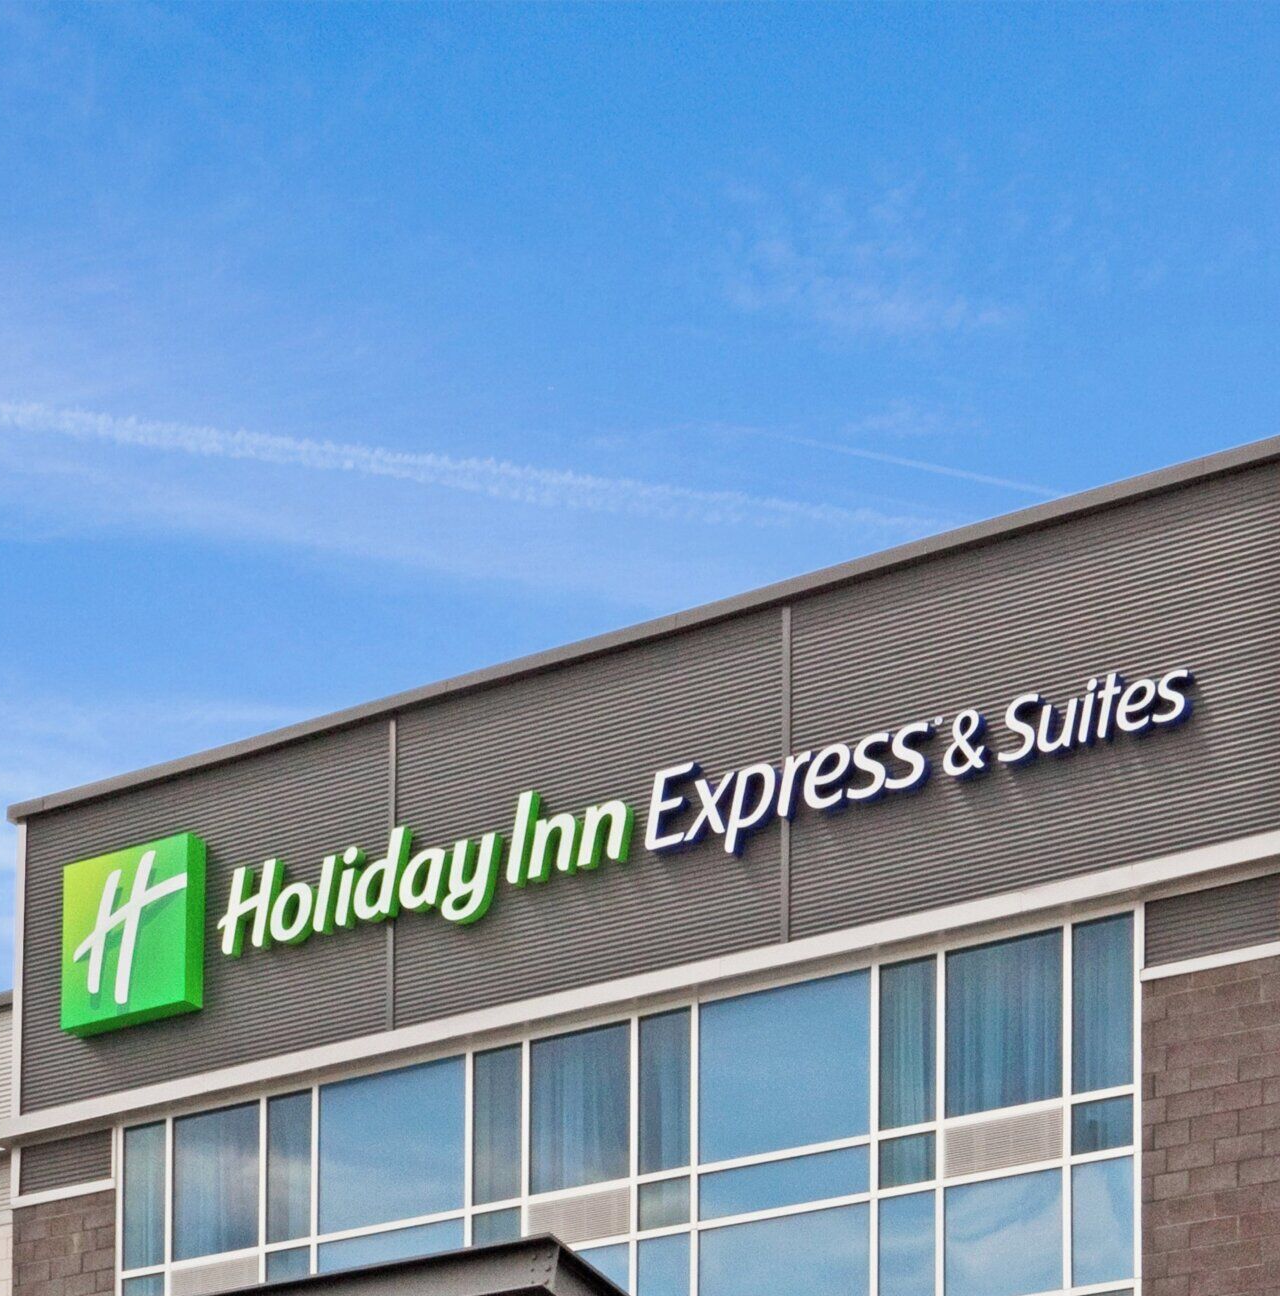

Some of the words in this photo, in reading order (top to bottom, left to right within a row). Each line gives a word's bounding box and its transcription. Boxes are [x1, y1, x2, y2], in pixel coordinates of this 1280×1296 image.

[217, 826, 501, 955] Holiday
[505, 791, 632, 886] Inn
[644, 720, 930, 853] Express
[942, 709, 988, 777] &
[997, 668, 1192, 764] Suites
